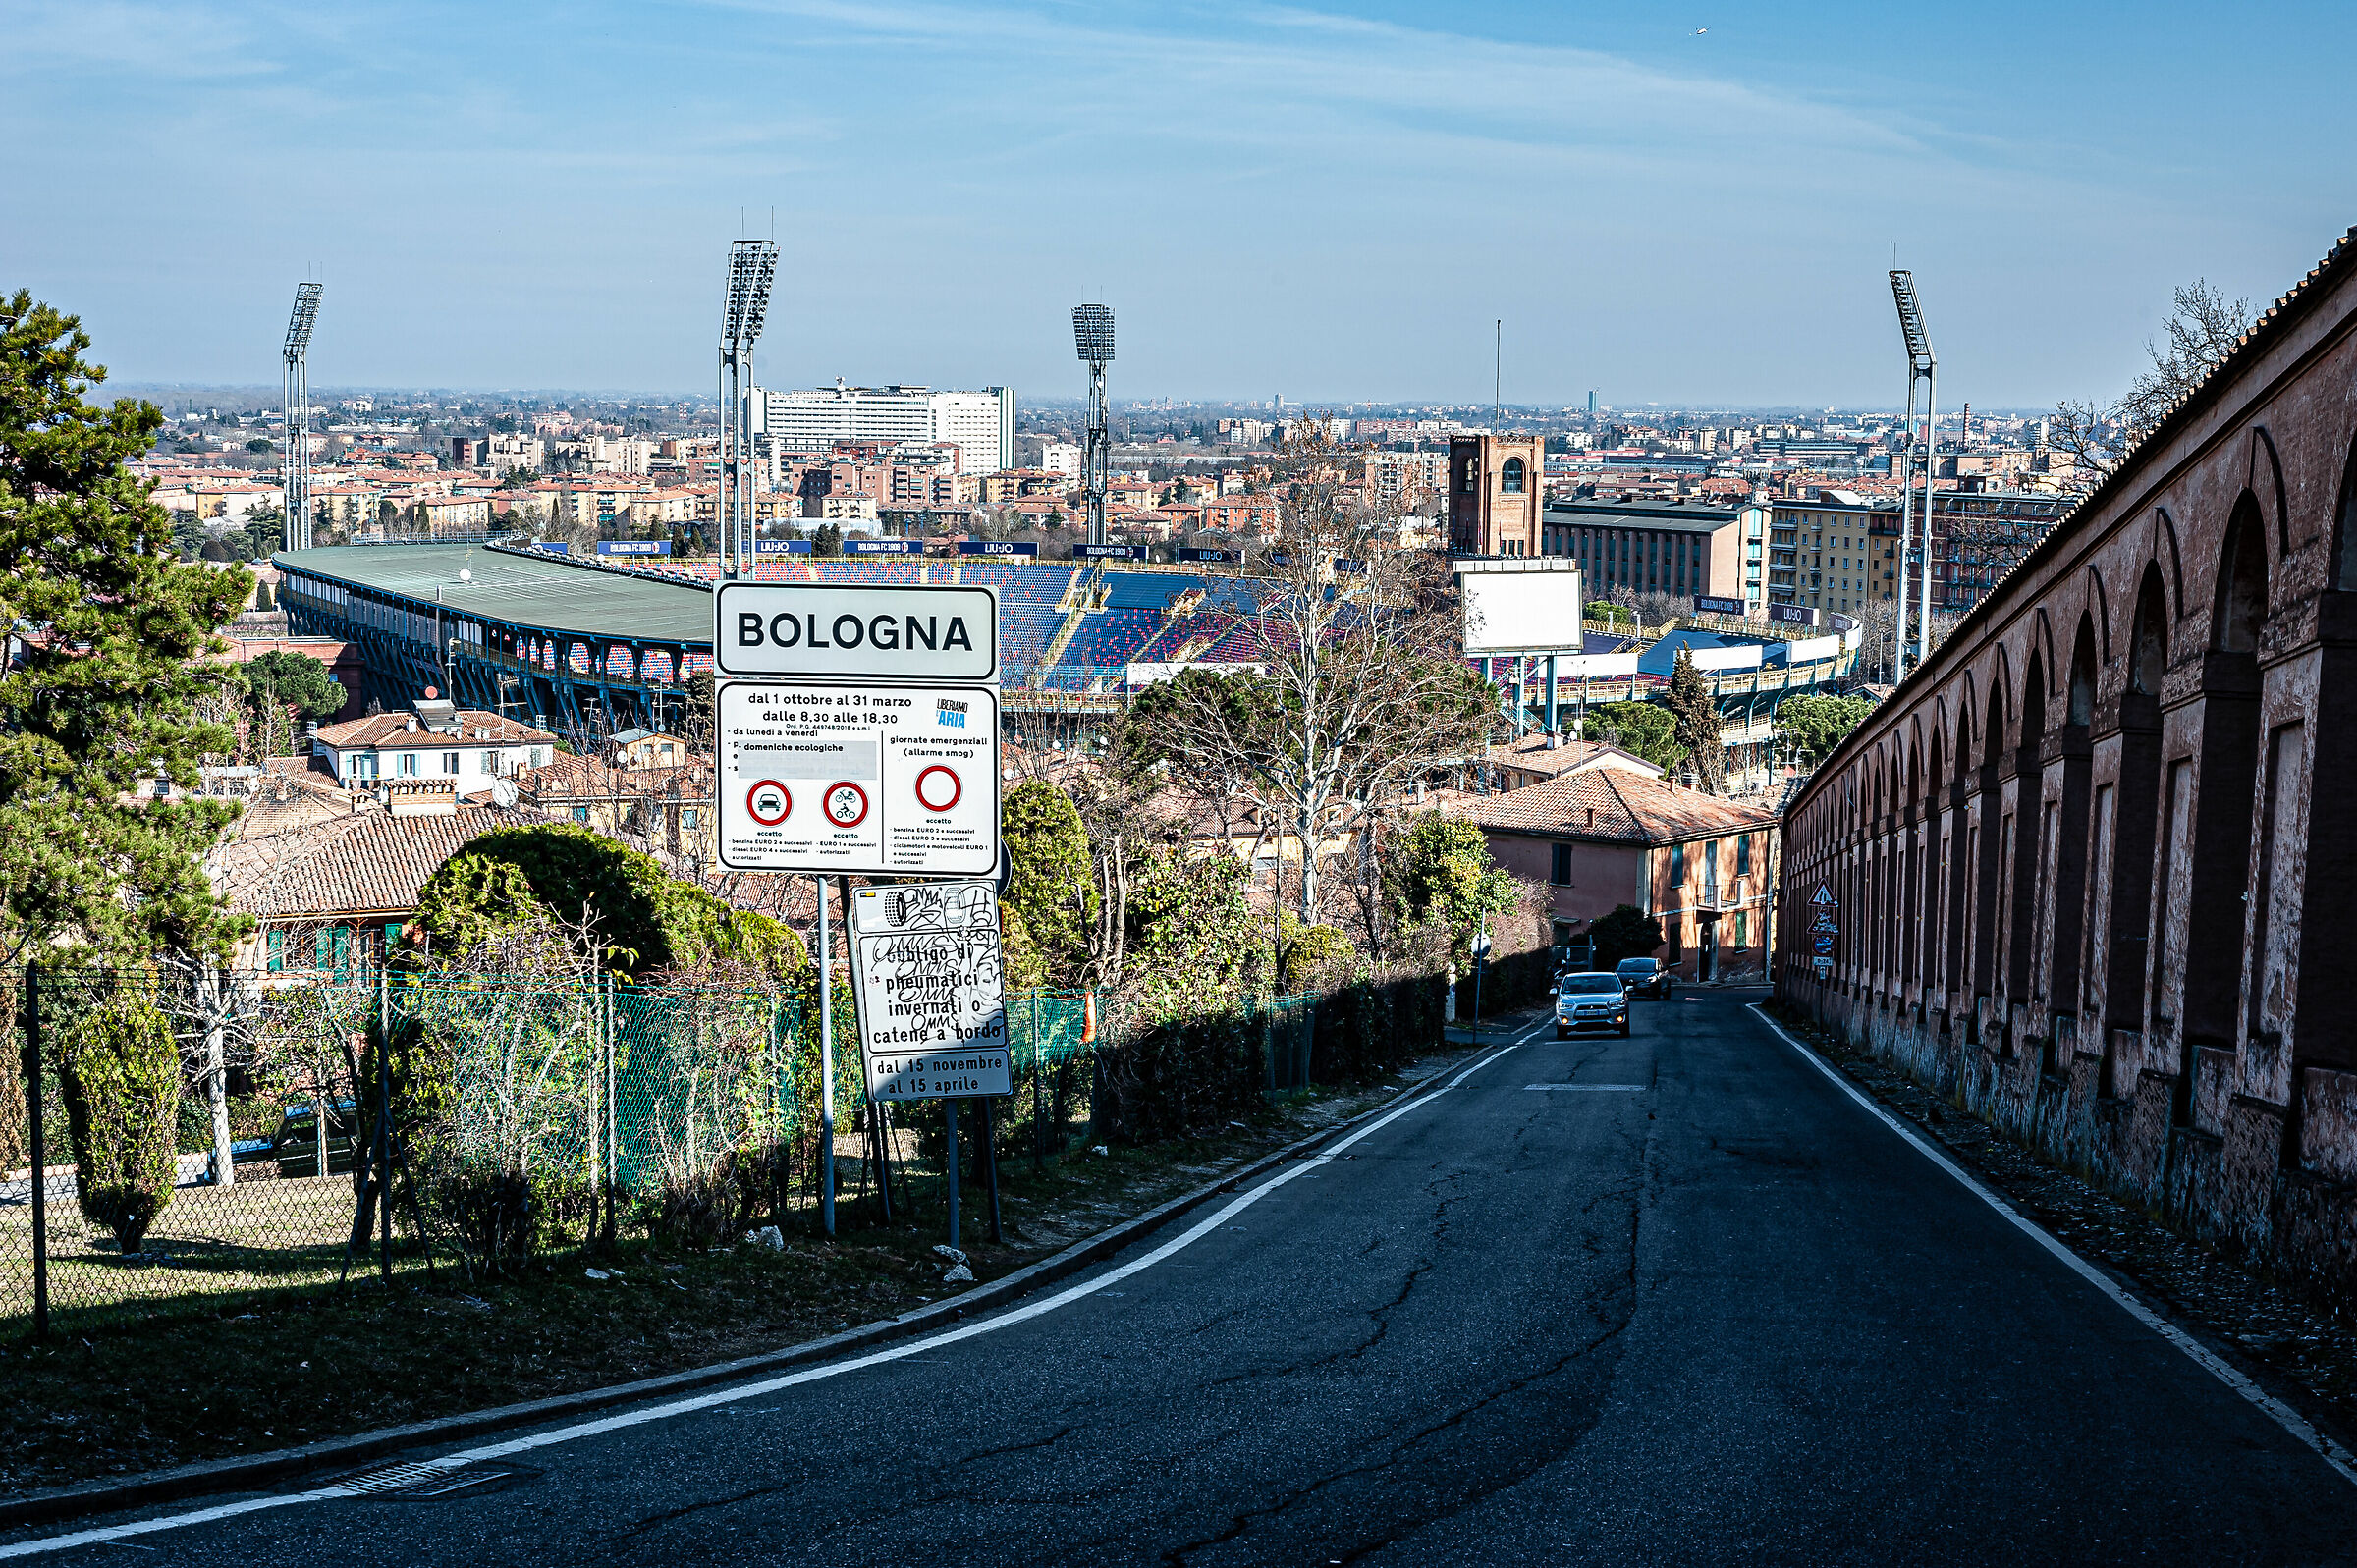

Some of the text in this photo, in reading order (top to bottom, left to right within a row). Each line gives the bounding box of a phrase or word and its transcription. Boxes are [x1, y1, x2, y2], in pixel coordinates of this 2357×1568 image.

[1087, 546, 1107, 555] BOLOGNA
[739, 613, 972, 651] BOLOGNA
[748, 693, 769, 703] dal
[774, 693, 778, 703] 1
[784, 694, 832, 705] ottobre
[837, 695, 849, 705] al
[853, 695, 866, 705] 31
[936, 698, 968, 713] LIBERIAMO
[763, 711, 898, 724] dalle 8.30 alle 18.30
[887, 943, 972, 965] obbligo di
[886, 969, 979, 994] pneumatici
[972, 1000, 980, 1012] o
[874, 1021, 1000, 1043] catene a bordo
[877, 1055, 1002, 1074] dal 15 novembre
[888, 1076, 979, 1094] al 15 aprile
